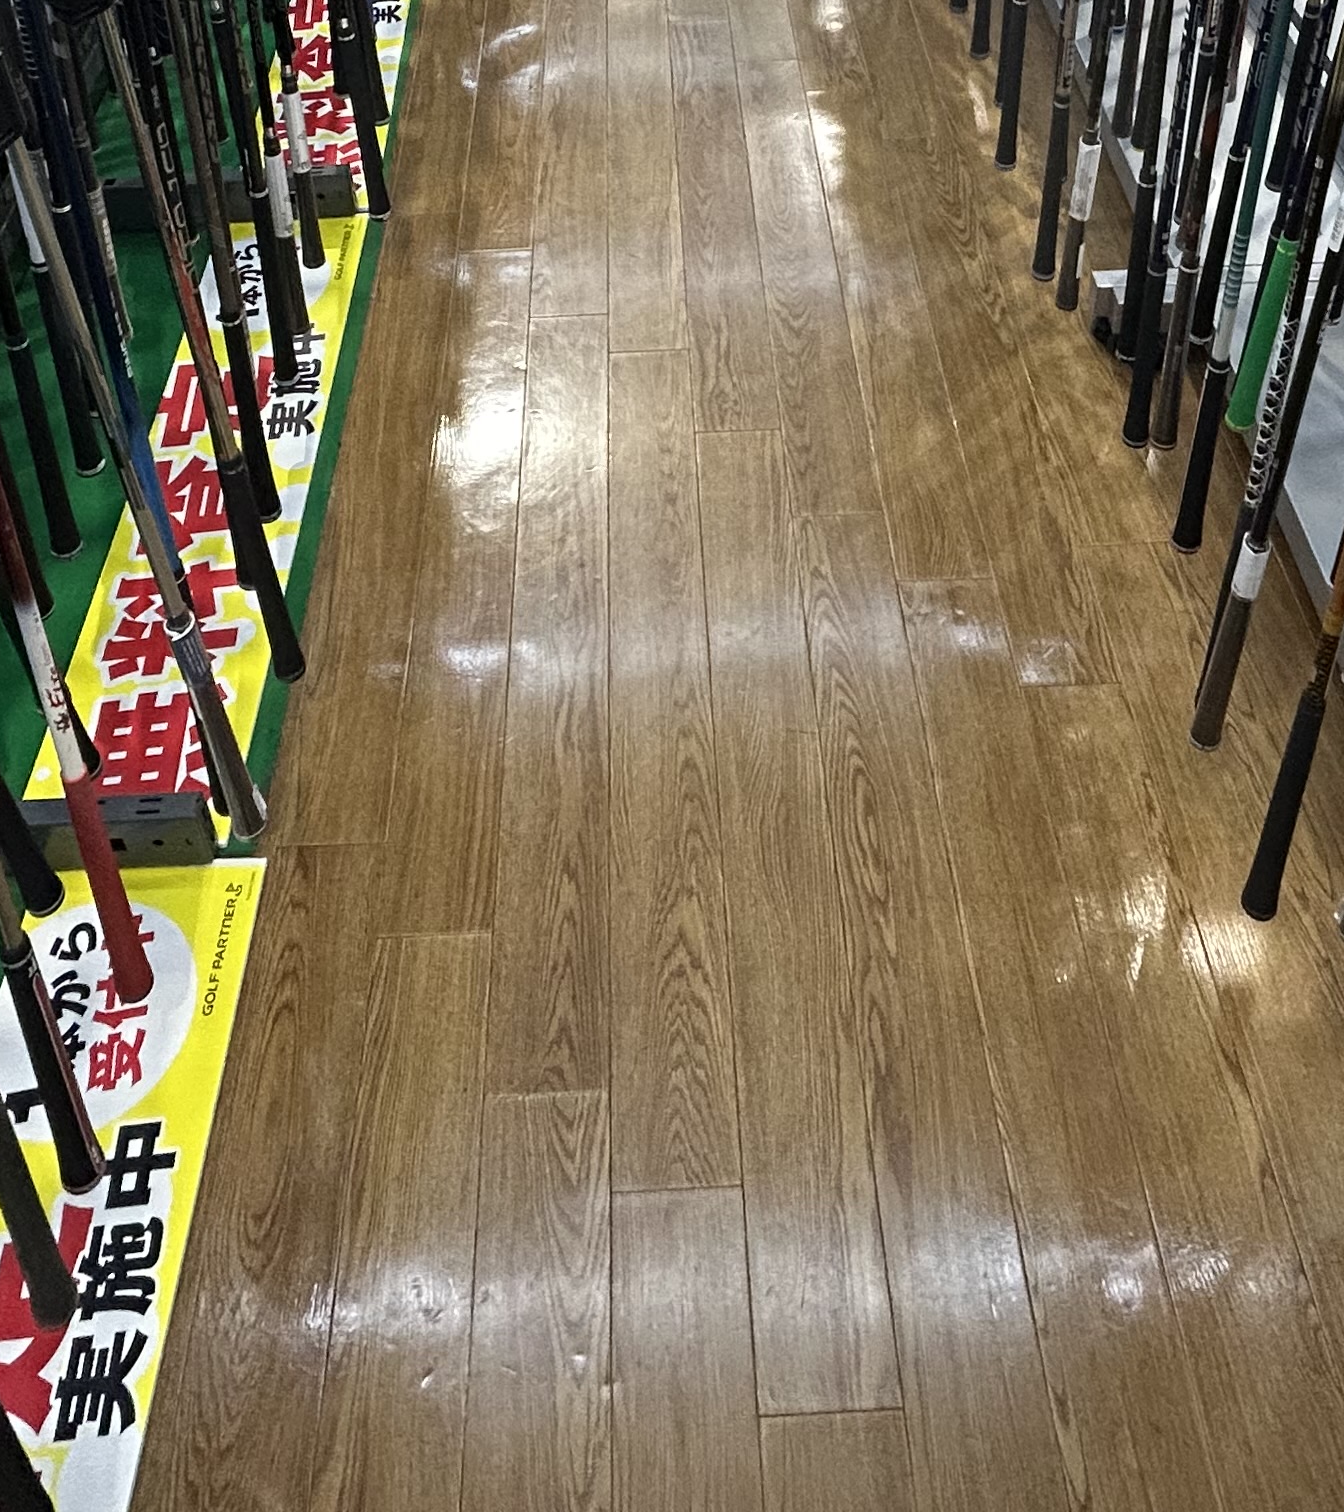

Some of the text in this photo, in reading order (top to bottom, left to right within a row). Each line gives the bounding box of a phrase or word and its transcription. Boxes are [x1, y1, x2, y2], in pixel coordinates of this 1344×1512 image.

[201, 897, 241, 1017] GOLF PARTNER
[53, 1119, 177, 1442] 実施中
